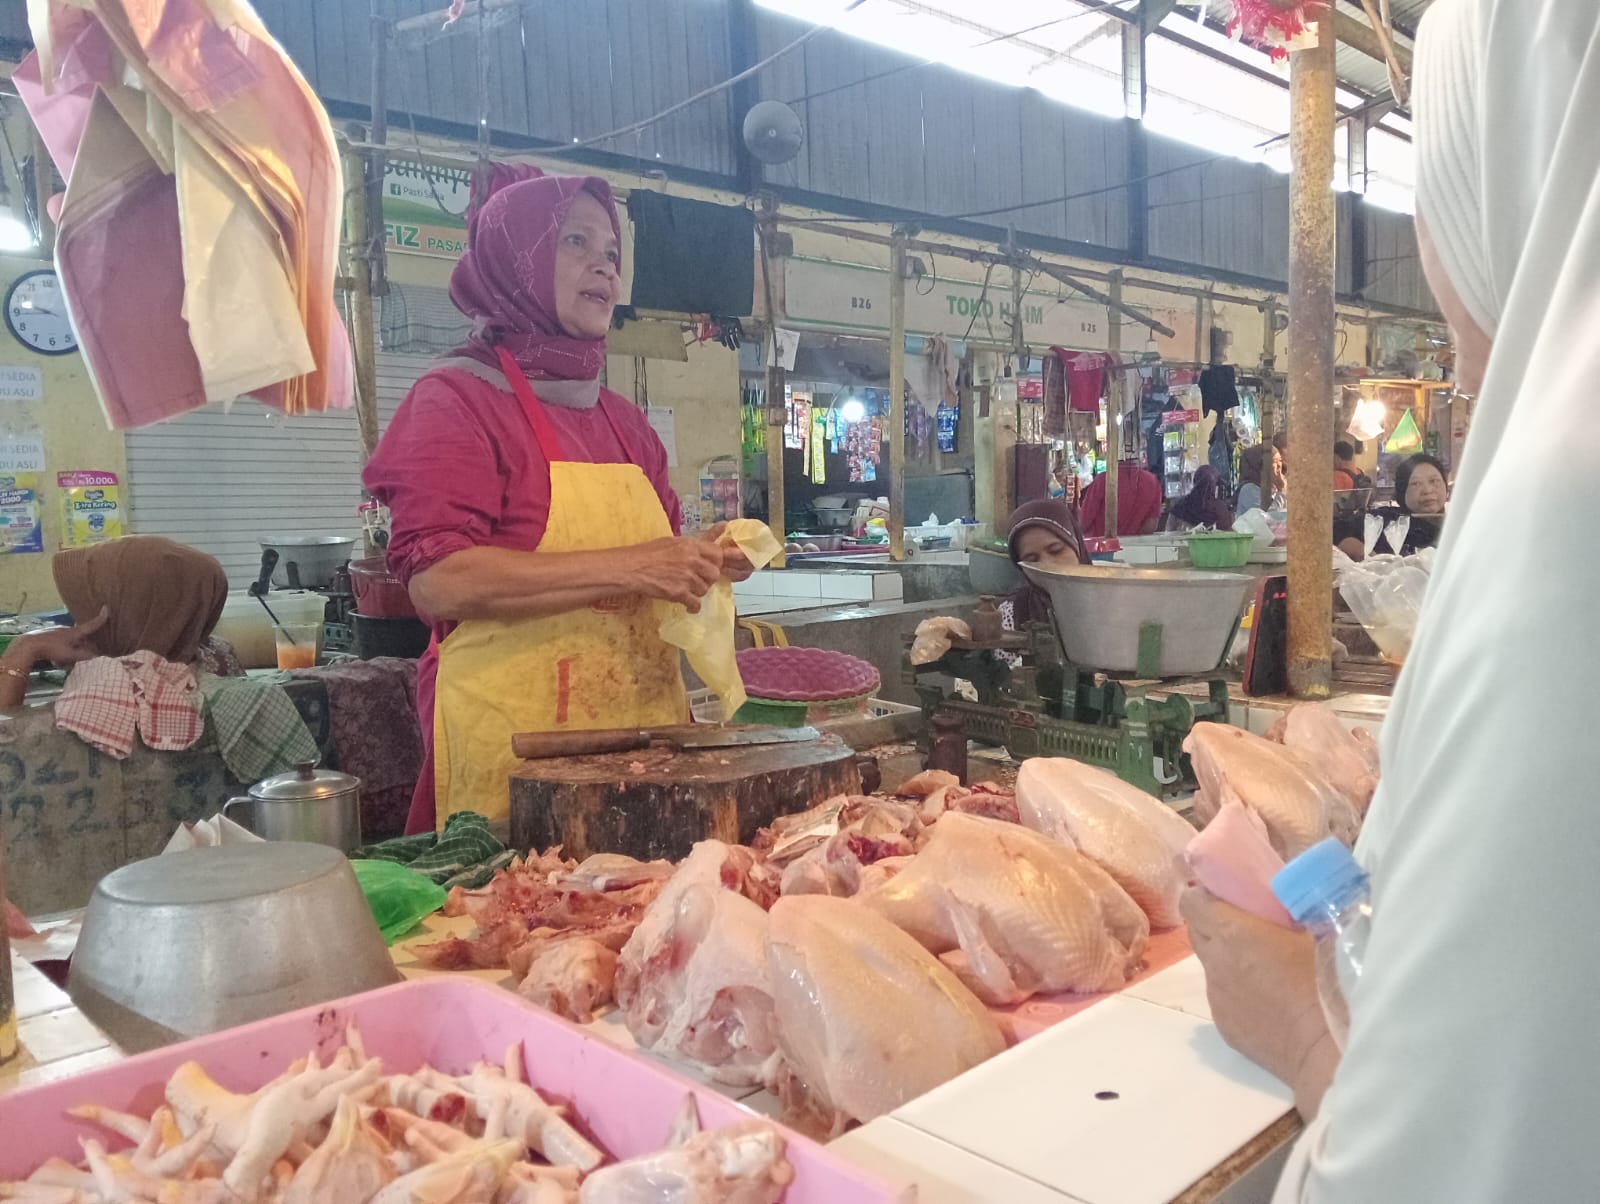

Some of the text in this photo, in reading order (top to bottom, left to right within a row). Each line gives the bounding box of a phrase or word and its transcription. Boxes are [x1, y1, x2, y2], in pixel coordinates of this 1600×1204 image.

[851, 296, 872, 311] B26
[14, 308, 20, 317] 9
[946, 295, 1043, 325] TOKO HIM
[33, 333, 39, 342] 7
[49, 337, 56, 346] 6
[65, 334, 72, 343] 5
[7, 371, 37, 381] SEDIA
[9, 444, 40, 455] SEDIA
